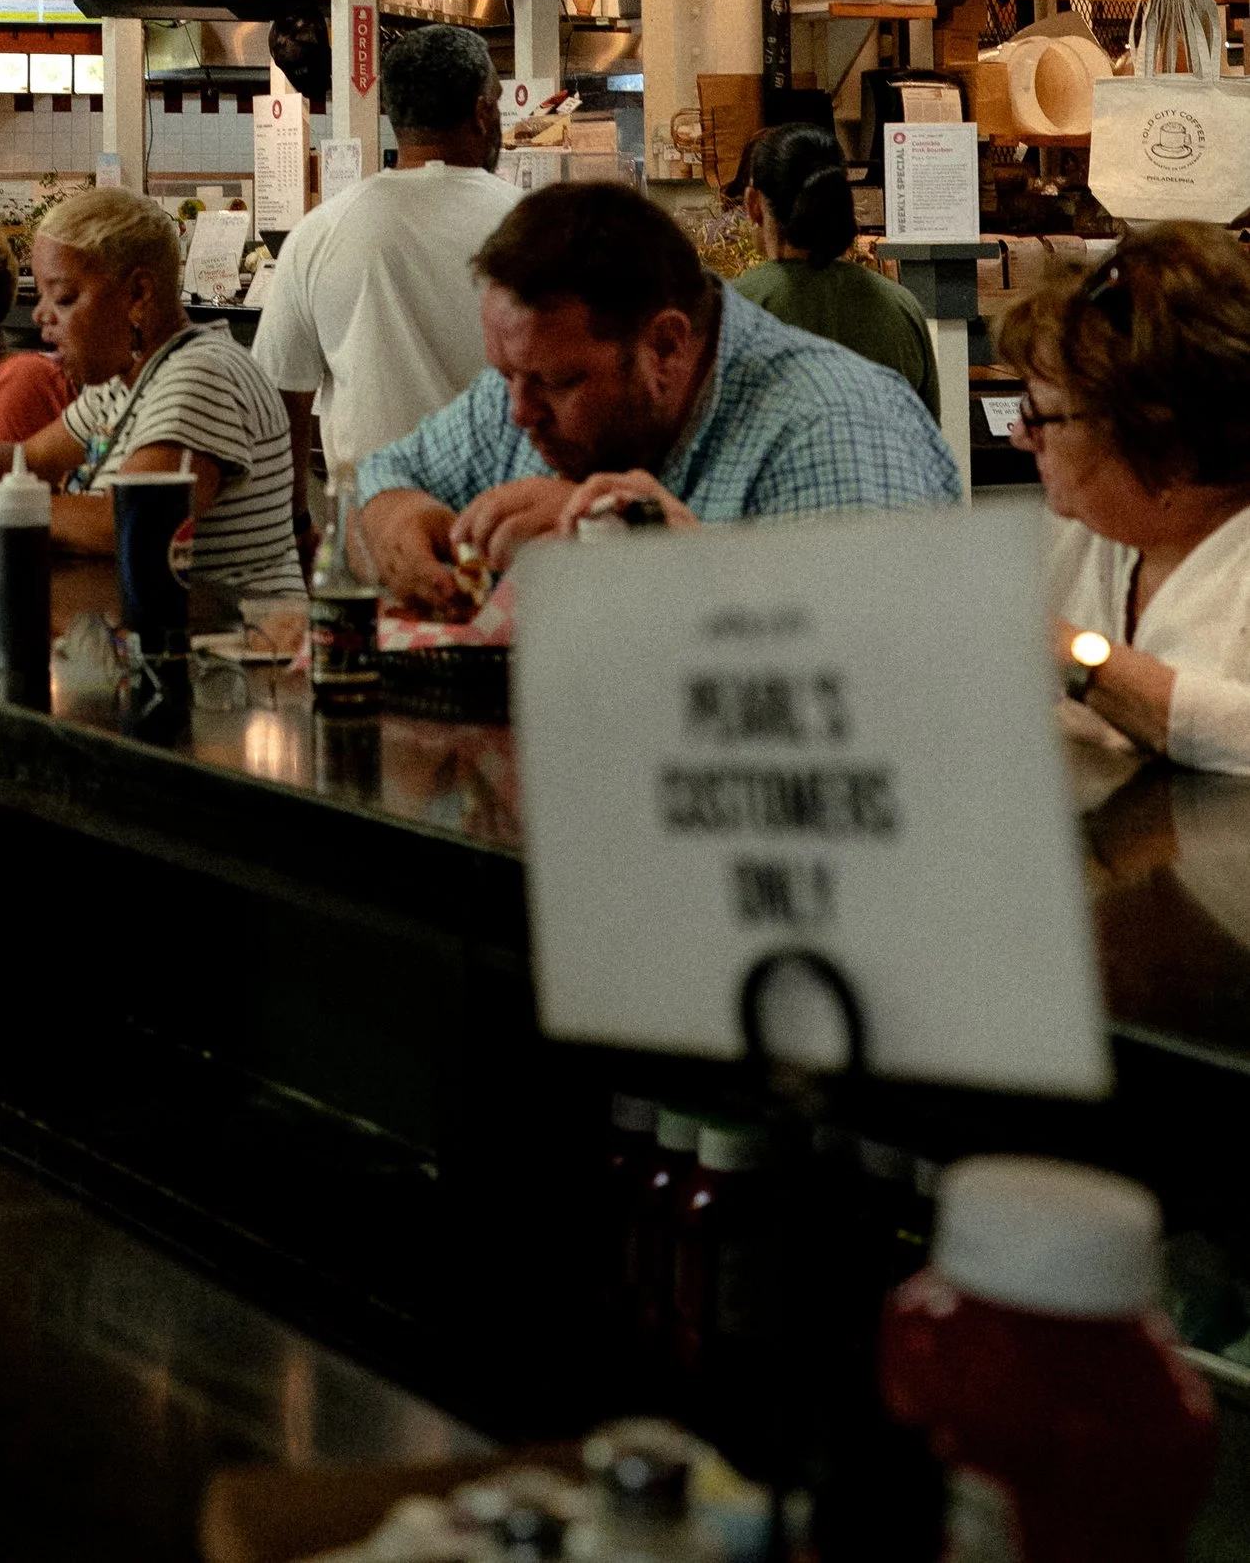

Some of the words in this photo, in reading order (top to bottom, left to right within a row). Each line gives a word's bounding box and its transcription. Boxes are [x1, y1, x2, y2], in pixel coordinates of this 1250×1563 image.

[357, 23, 368, 88] ORDER
[1142, 119, 1154, 138] OLD
[1155, 109, 1177, 120] CITY
[1179, 111, 1206, 142] COFFEE
[896, 148, 905, 190] SPECIAL
[1146, 175, 1195, 184] PHILADELPHIA
[897, 192, 906, 234] WEEKLY
